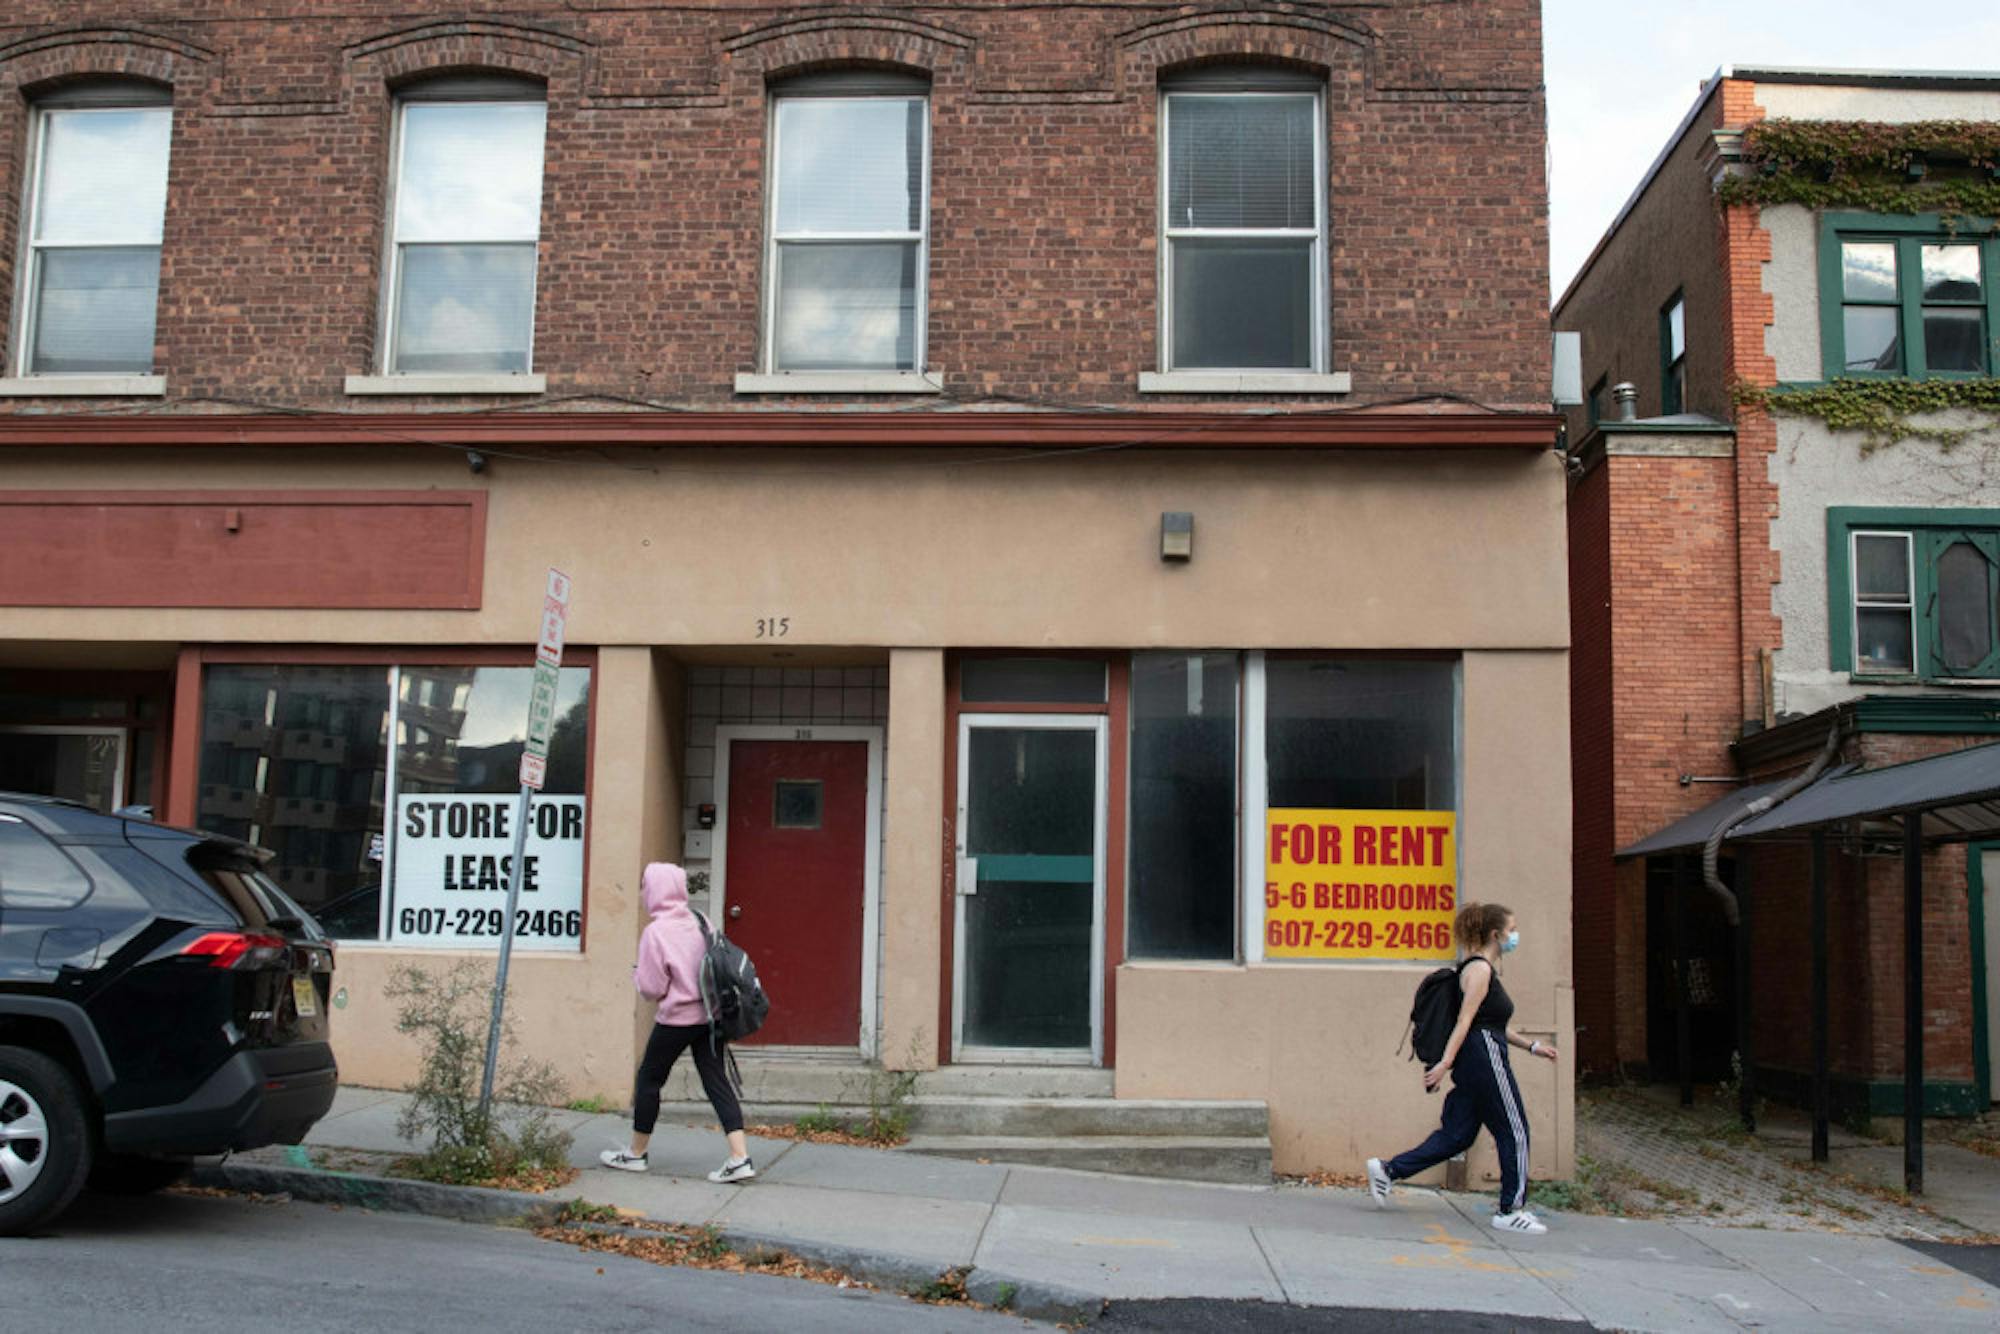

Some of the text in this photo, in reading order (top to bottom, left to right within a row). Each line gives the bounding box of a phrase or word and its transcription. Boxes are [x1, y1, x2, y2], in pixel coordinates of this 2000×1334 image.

[755, 617, 791, 639] 315
[405, 802, 510, 838] STORE
[1270, 823, 1449, 866] FOR RENT
[1265, 882, 1455, 911] 5-6 BEDROOMS
[400, 908, 581, 938] 607-2292466
[1267, 919, 1450, 950] 607-229-2466
